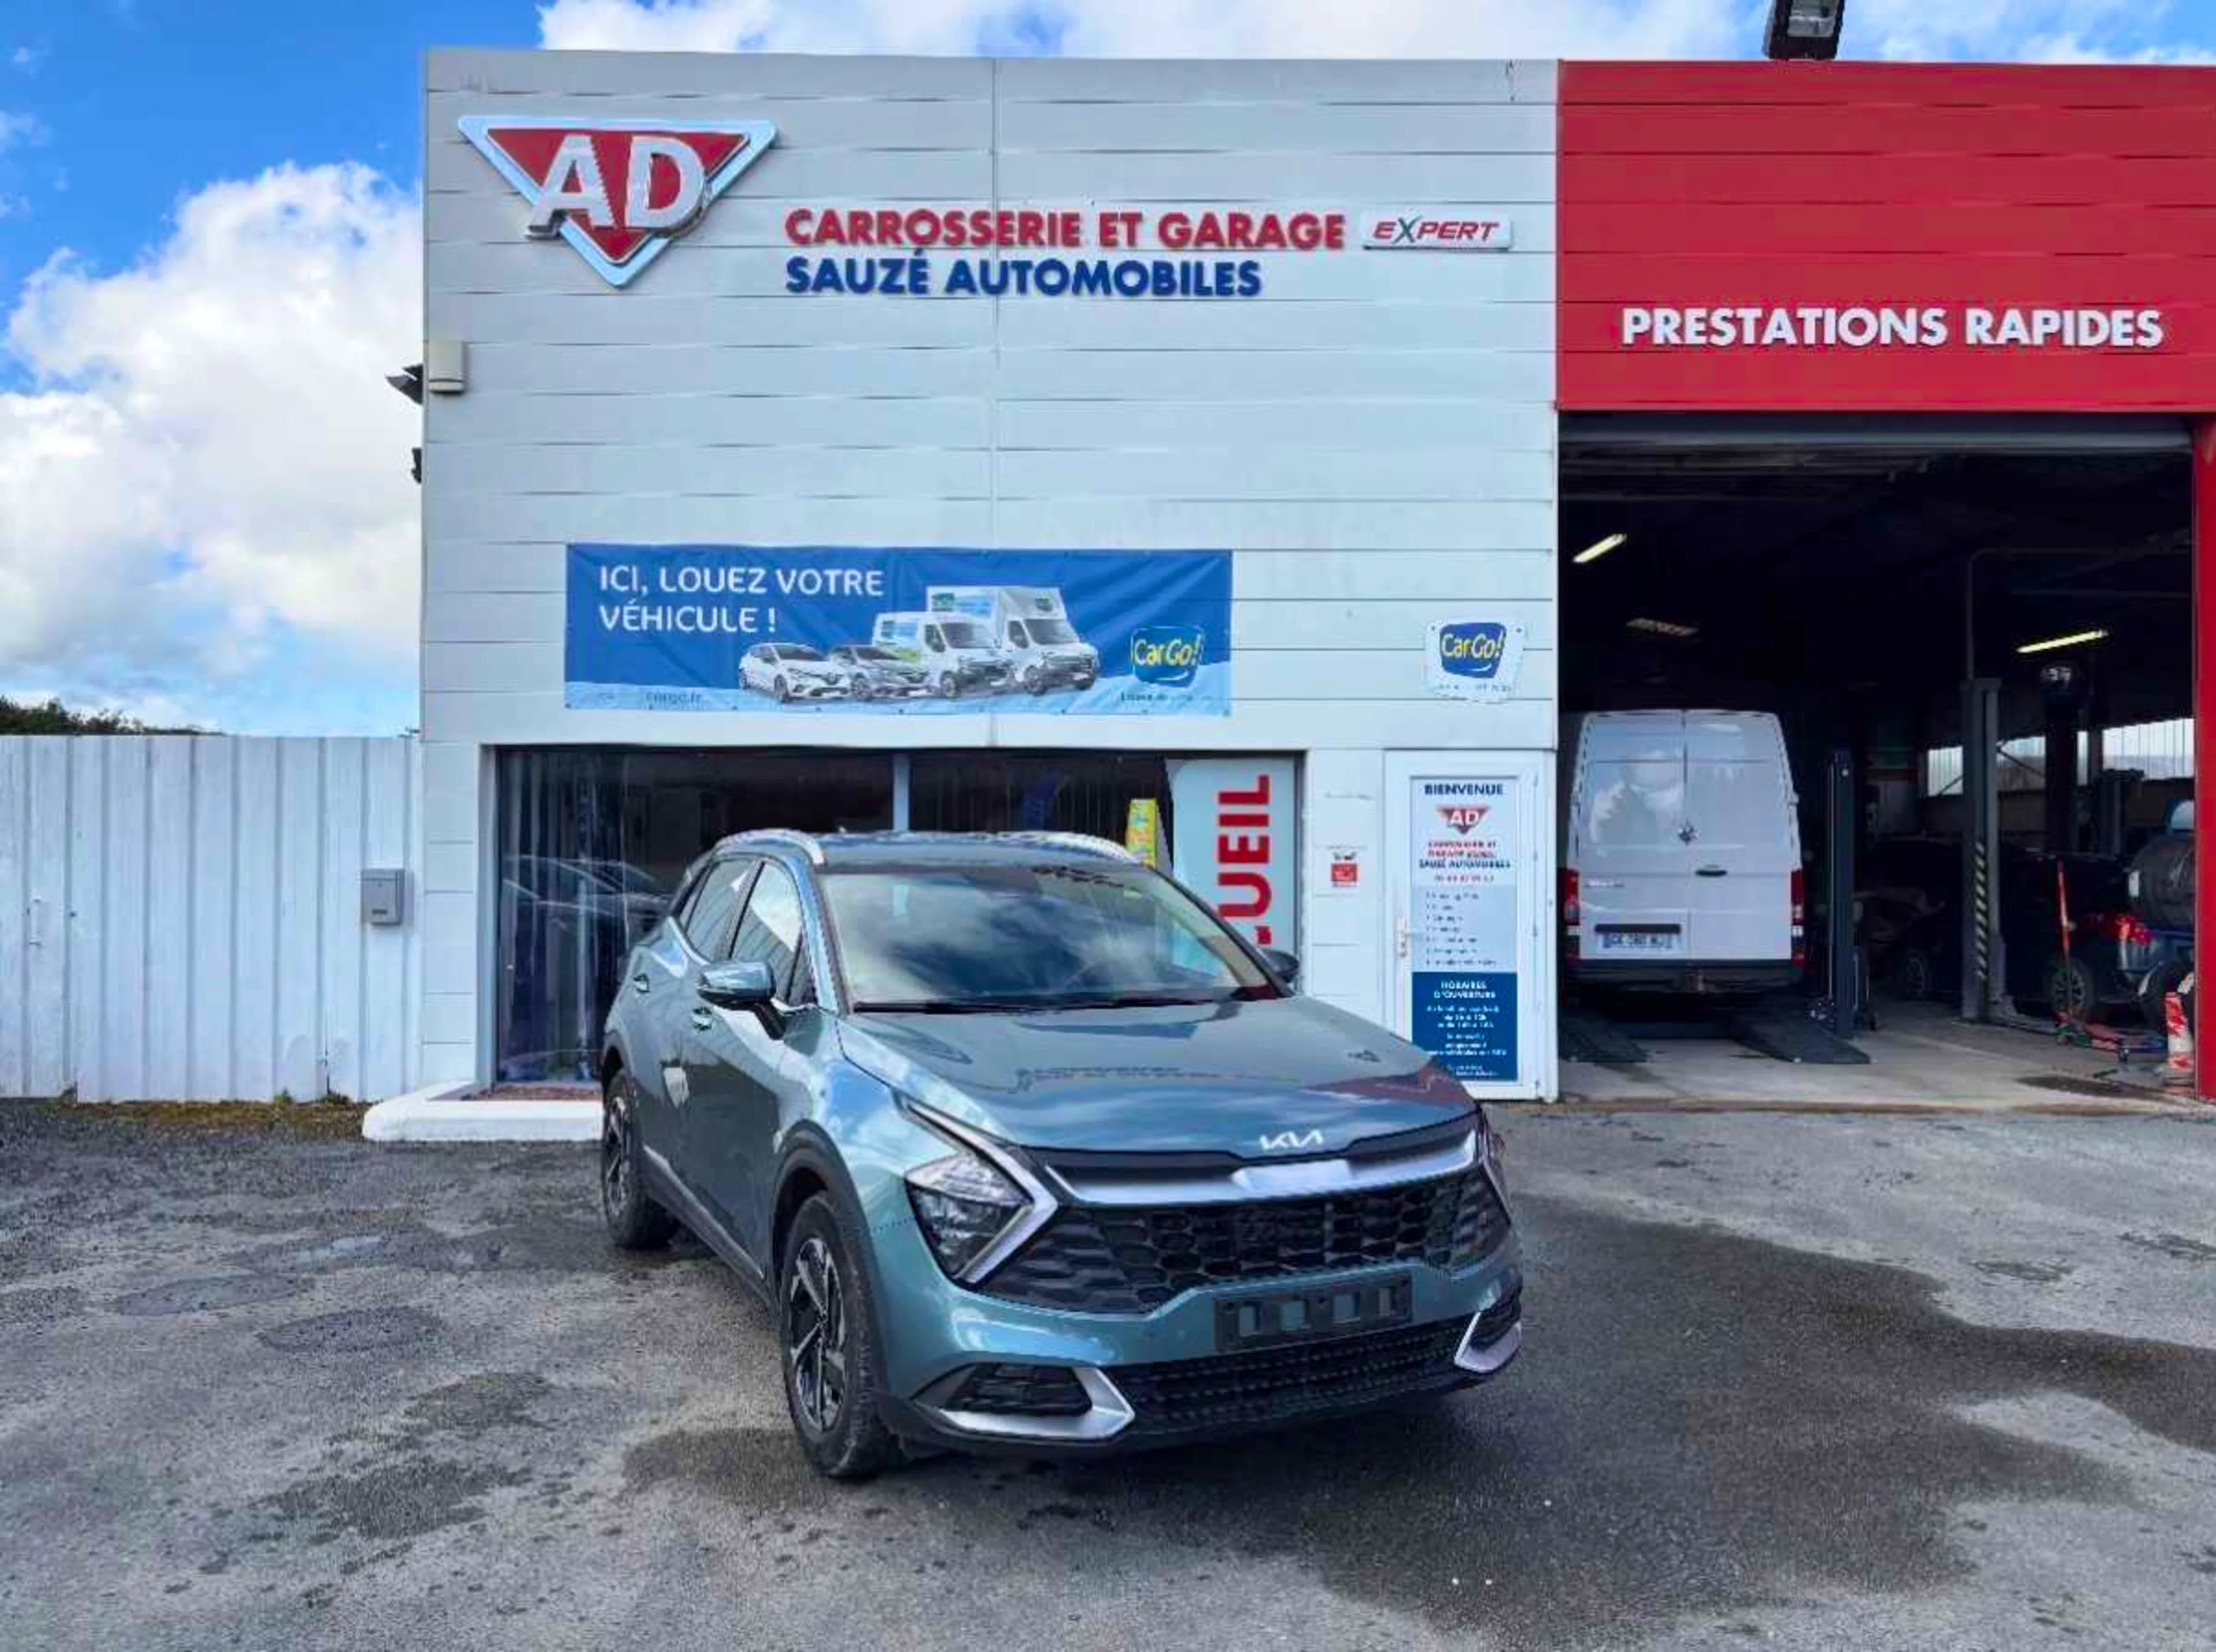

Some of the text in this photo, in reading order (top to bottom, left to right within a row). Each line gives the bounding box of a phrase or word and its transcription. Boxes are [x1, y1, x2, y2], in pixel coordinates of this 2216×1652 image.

[527, 133, 709, 234] AD
[785, 208, 1345, 251] CARROSSERIE ET GARAGE
[1372, 215, 1500, 244] EXPERT
[785, 249, 1262, 297] SAUZÉ AUTOMOBILES
[1622, 307, 2164, 347] PRESTATIONS RAPIDES
[600, 565, 885, 597] ICI, LOUEZ VOTRE
[599, 599, 777, 633] VÉHICULE !
[1133, 634, 1202, 666] CarGo!
[1442, 628, 1504, 659] CarGo!
[1424, 784, 1504, 796] BIENVENUE
[1448, 809, 1480, 825] AD
[1259, 1129, 1324, 1150] KIA
